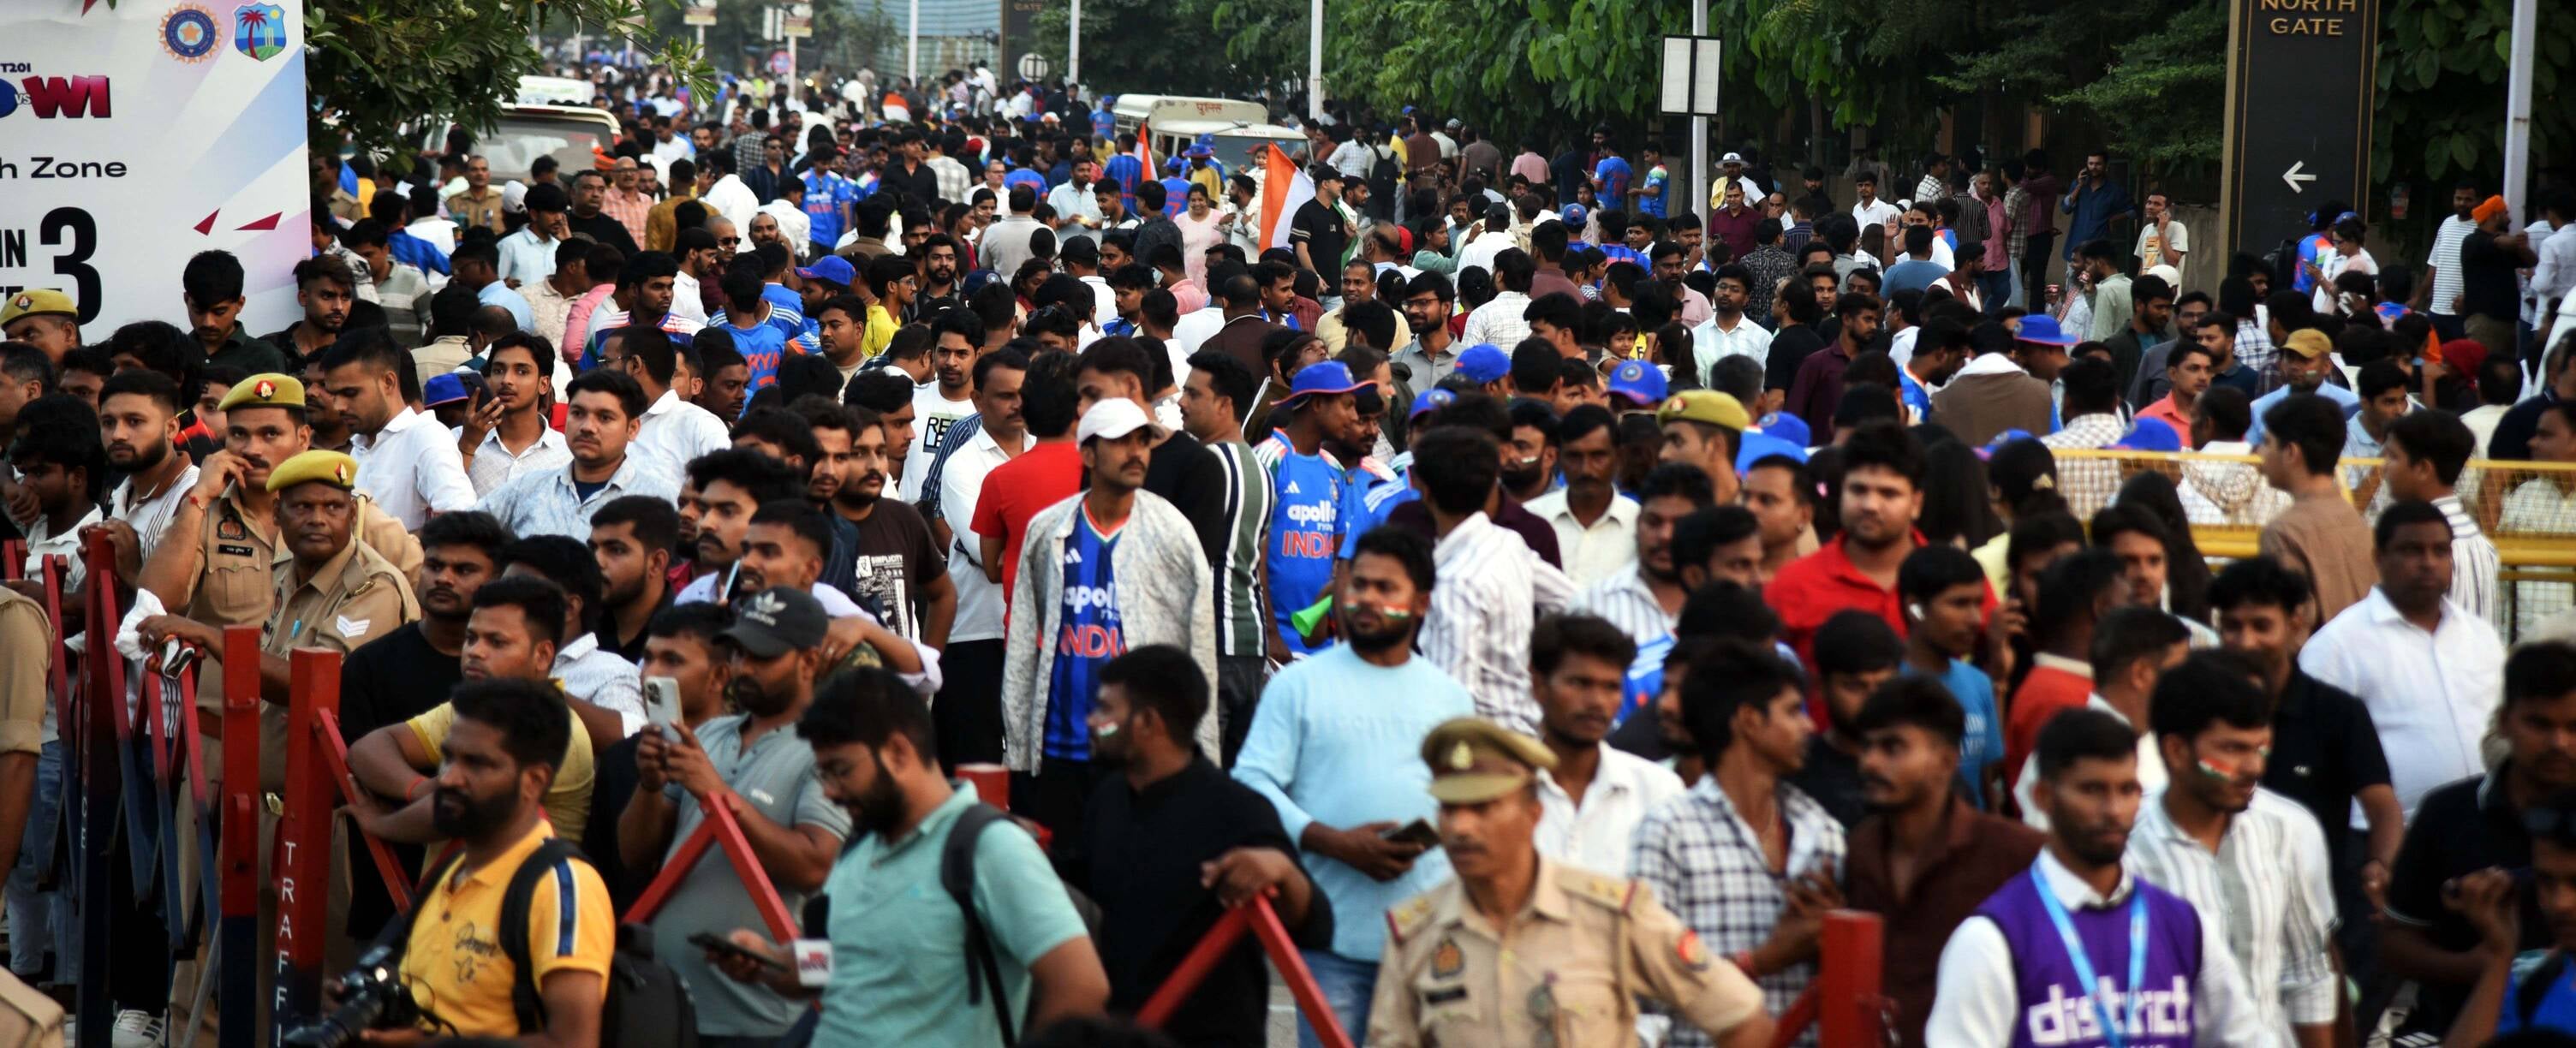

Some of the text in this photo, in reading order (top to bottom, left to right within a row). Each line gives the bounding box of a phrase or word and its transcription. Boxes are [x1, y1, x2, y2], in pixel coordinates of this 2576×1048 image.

[2261, 0, 2357, 12] NORTH
[2269, 18, 2344, 35] GATE
[21, 74, 111, 119] WI
[31, 157, 128, 179] Zone
[40, 206, 103, 326] 3
[1287, 499, 1337, 527] apollo
[2028, 975, 2191, 1045] district
